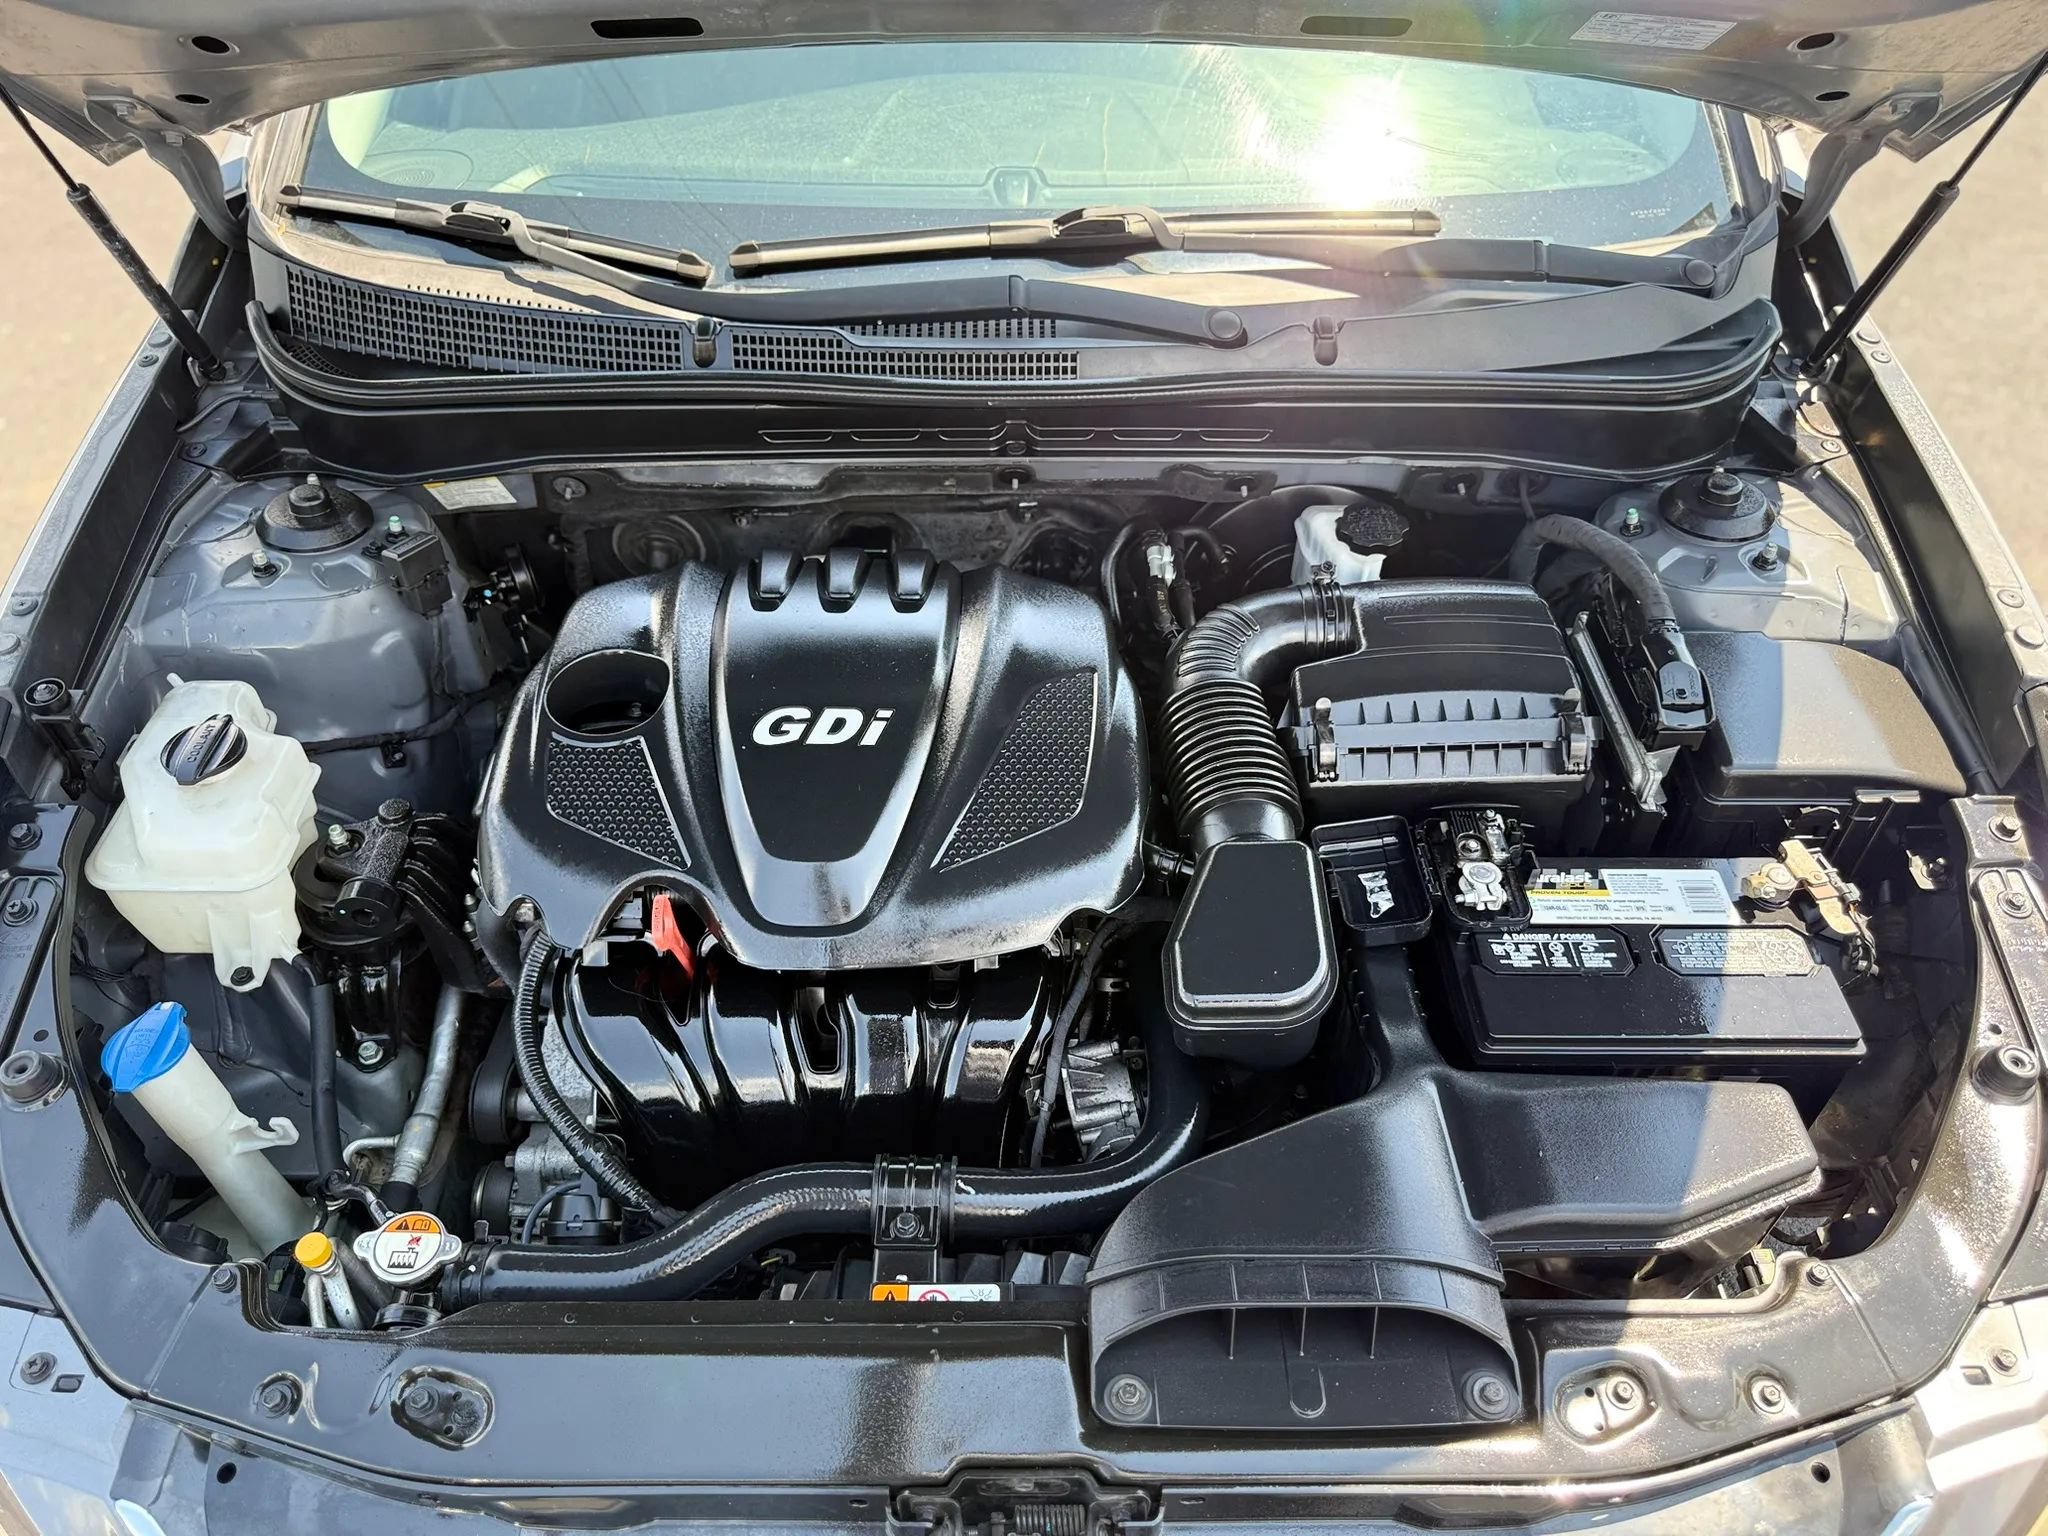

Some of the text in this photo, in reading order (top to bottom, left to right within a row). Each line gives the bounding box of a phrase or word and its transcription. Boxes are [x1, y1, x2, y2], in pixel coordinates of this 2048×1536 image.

[751, 706, 895, 747] GDi
[187, 724, 216, 763] COOLANT
[1594, 903, 1610, 911] 700
[1511, 933, 1552, 941] DANGER
[1559, 933, 1597, 941] POISON
